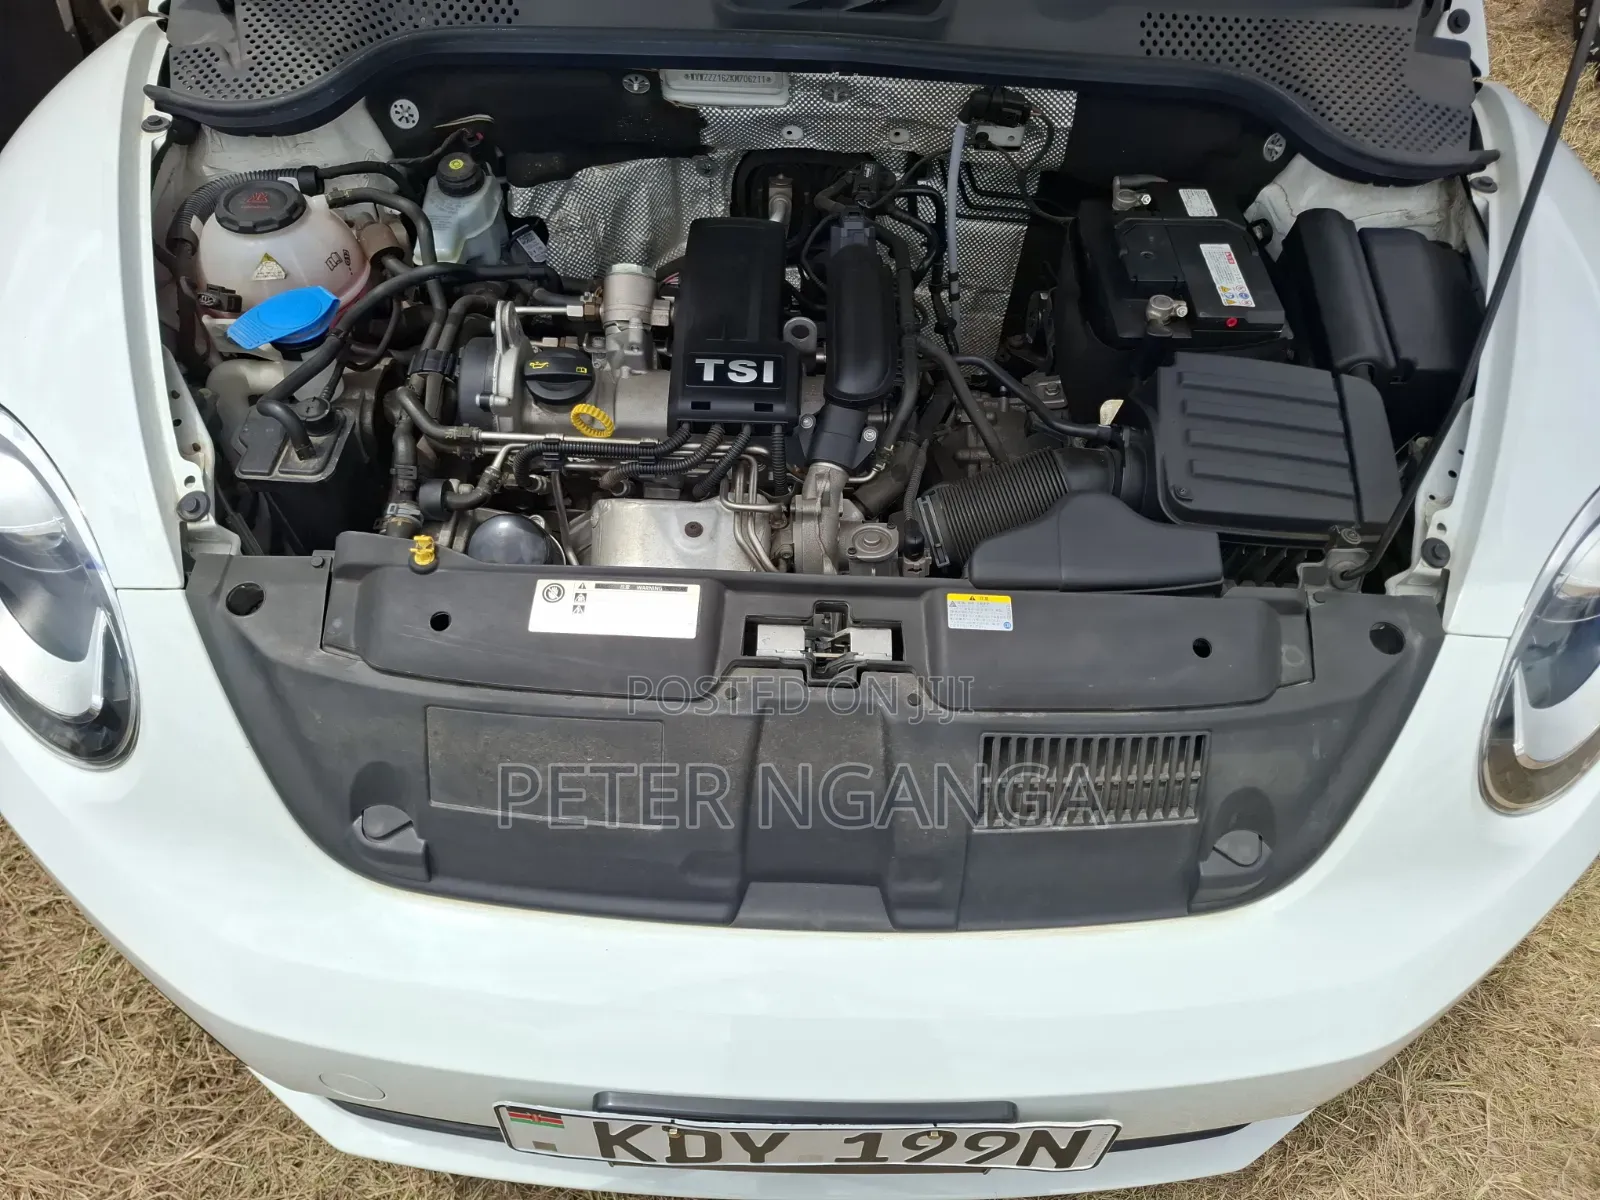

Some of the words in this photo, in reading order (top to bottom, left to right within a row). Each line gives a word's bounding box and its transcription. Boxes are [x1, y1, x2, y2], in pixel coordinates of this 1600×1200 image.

[695, 358, 774, 383] TSI
[593, 1121, 790, 1164] KDY
[834, 1129, 1092, 1169] 199N
